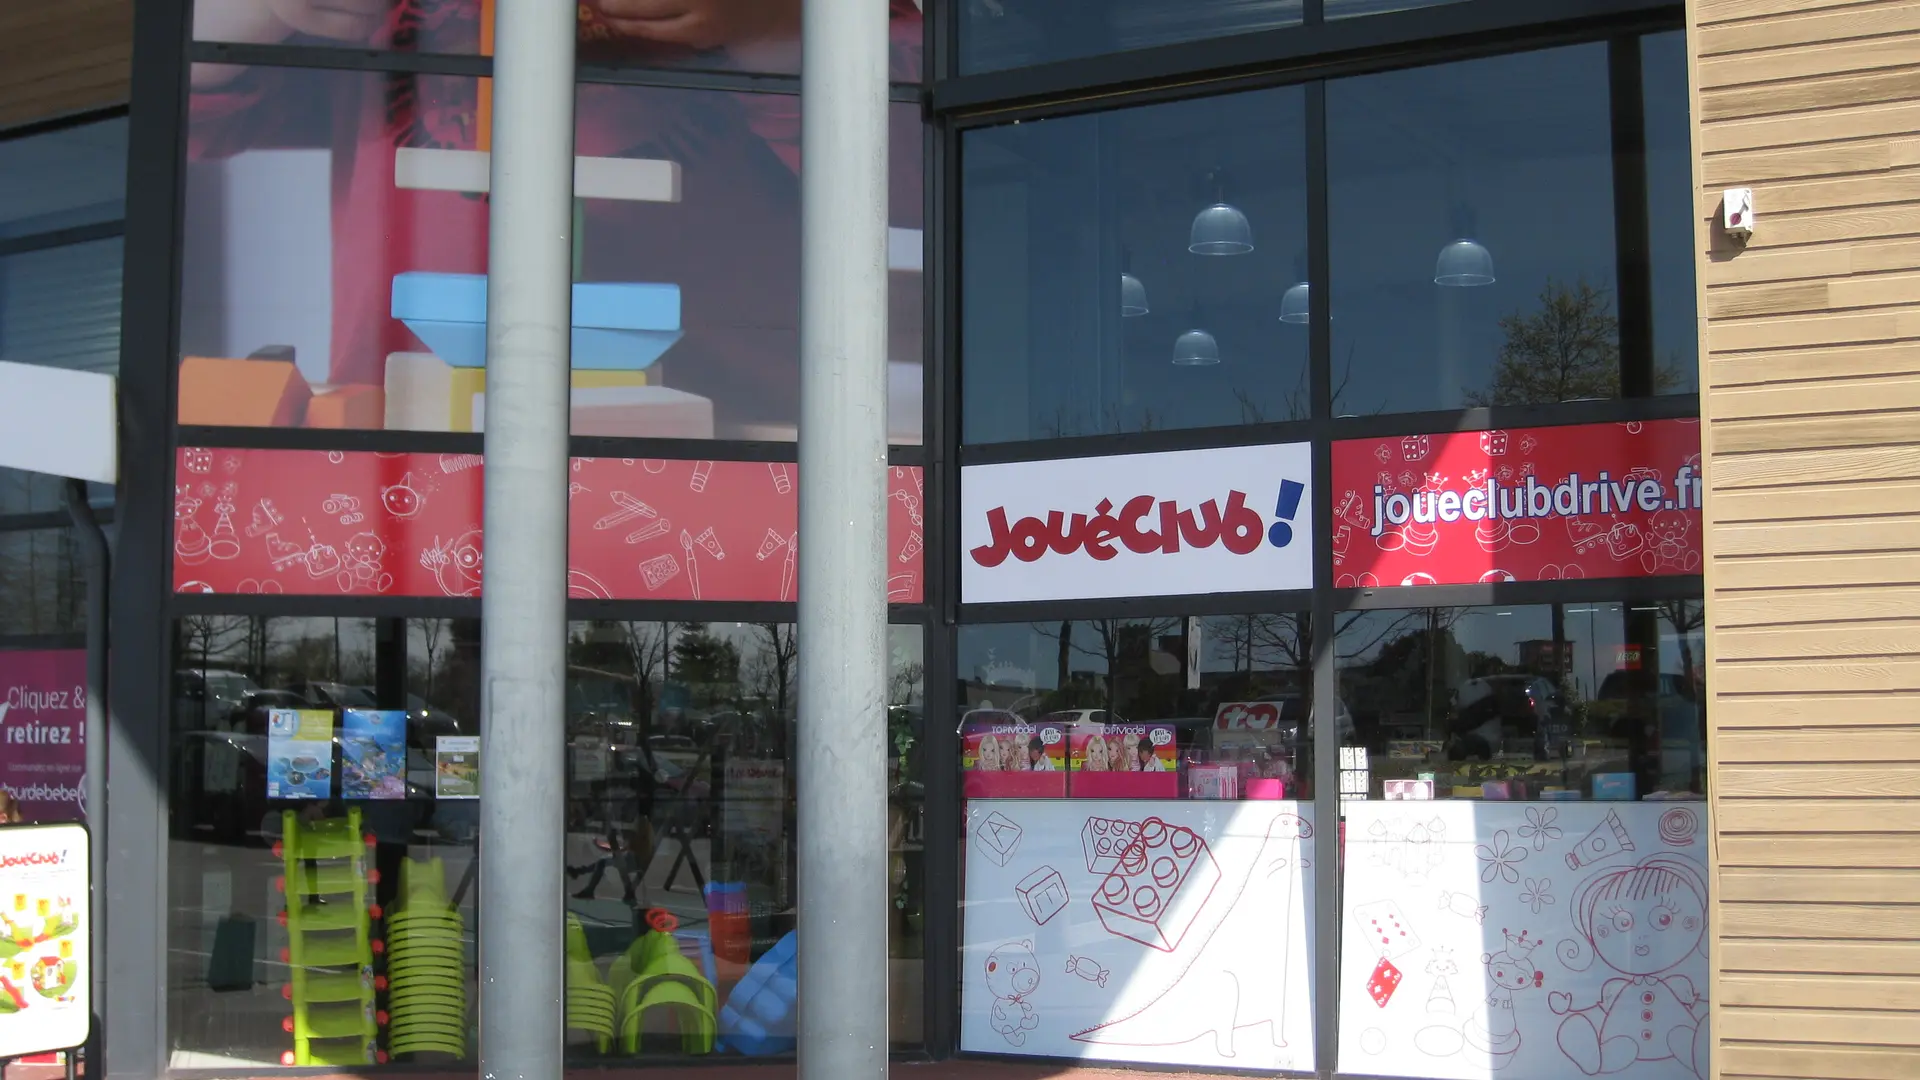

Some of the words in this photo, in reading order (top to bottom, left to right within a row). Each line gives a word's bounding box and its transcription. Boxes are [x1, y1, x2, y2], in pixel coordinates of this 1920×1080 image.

[7, 685, 69, 714] Cliquez
[73, 685, 85, 709] &
[7, 720, 71, 744] retirez
[78, 720, 85, 744] !
